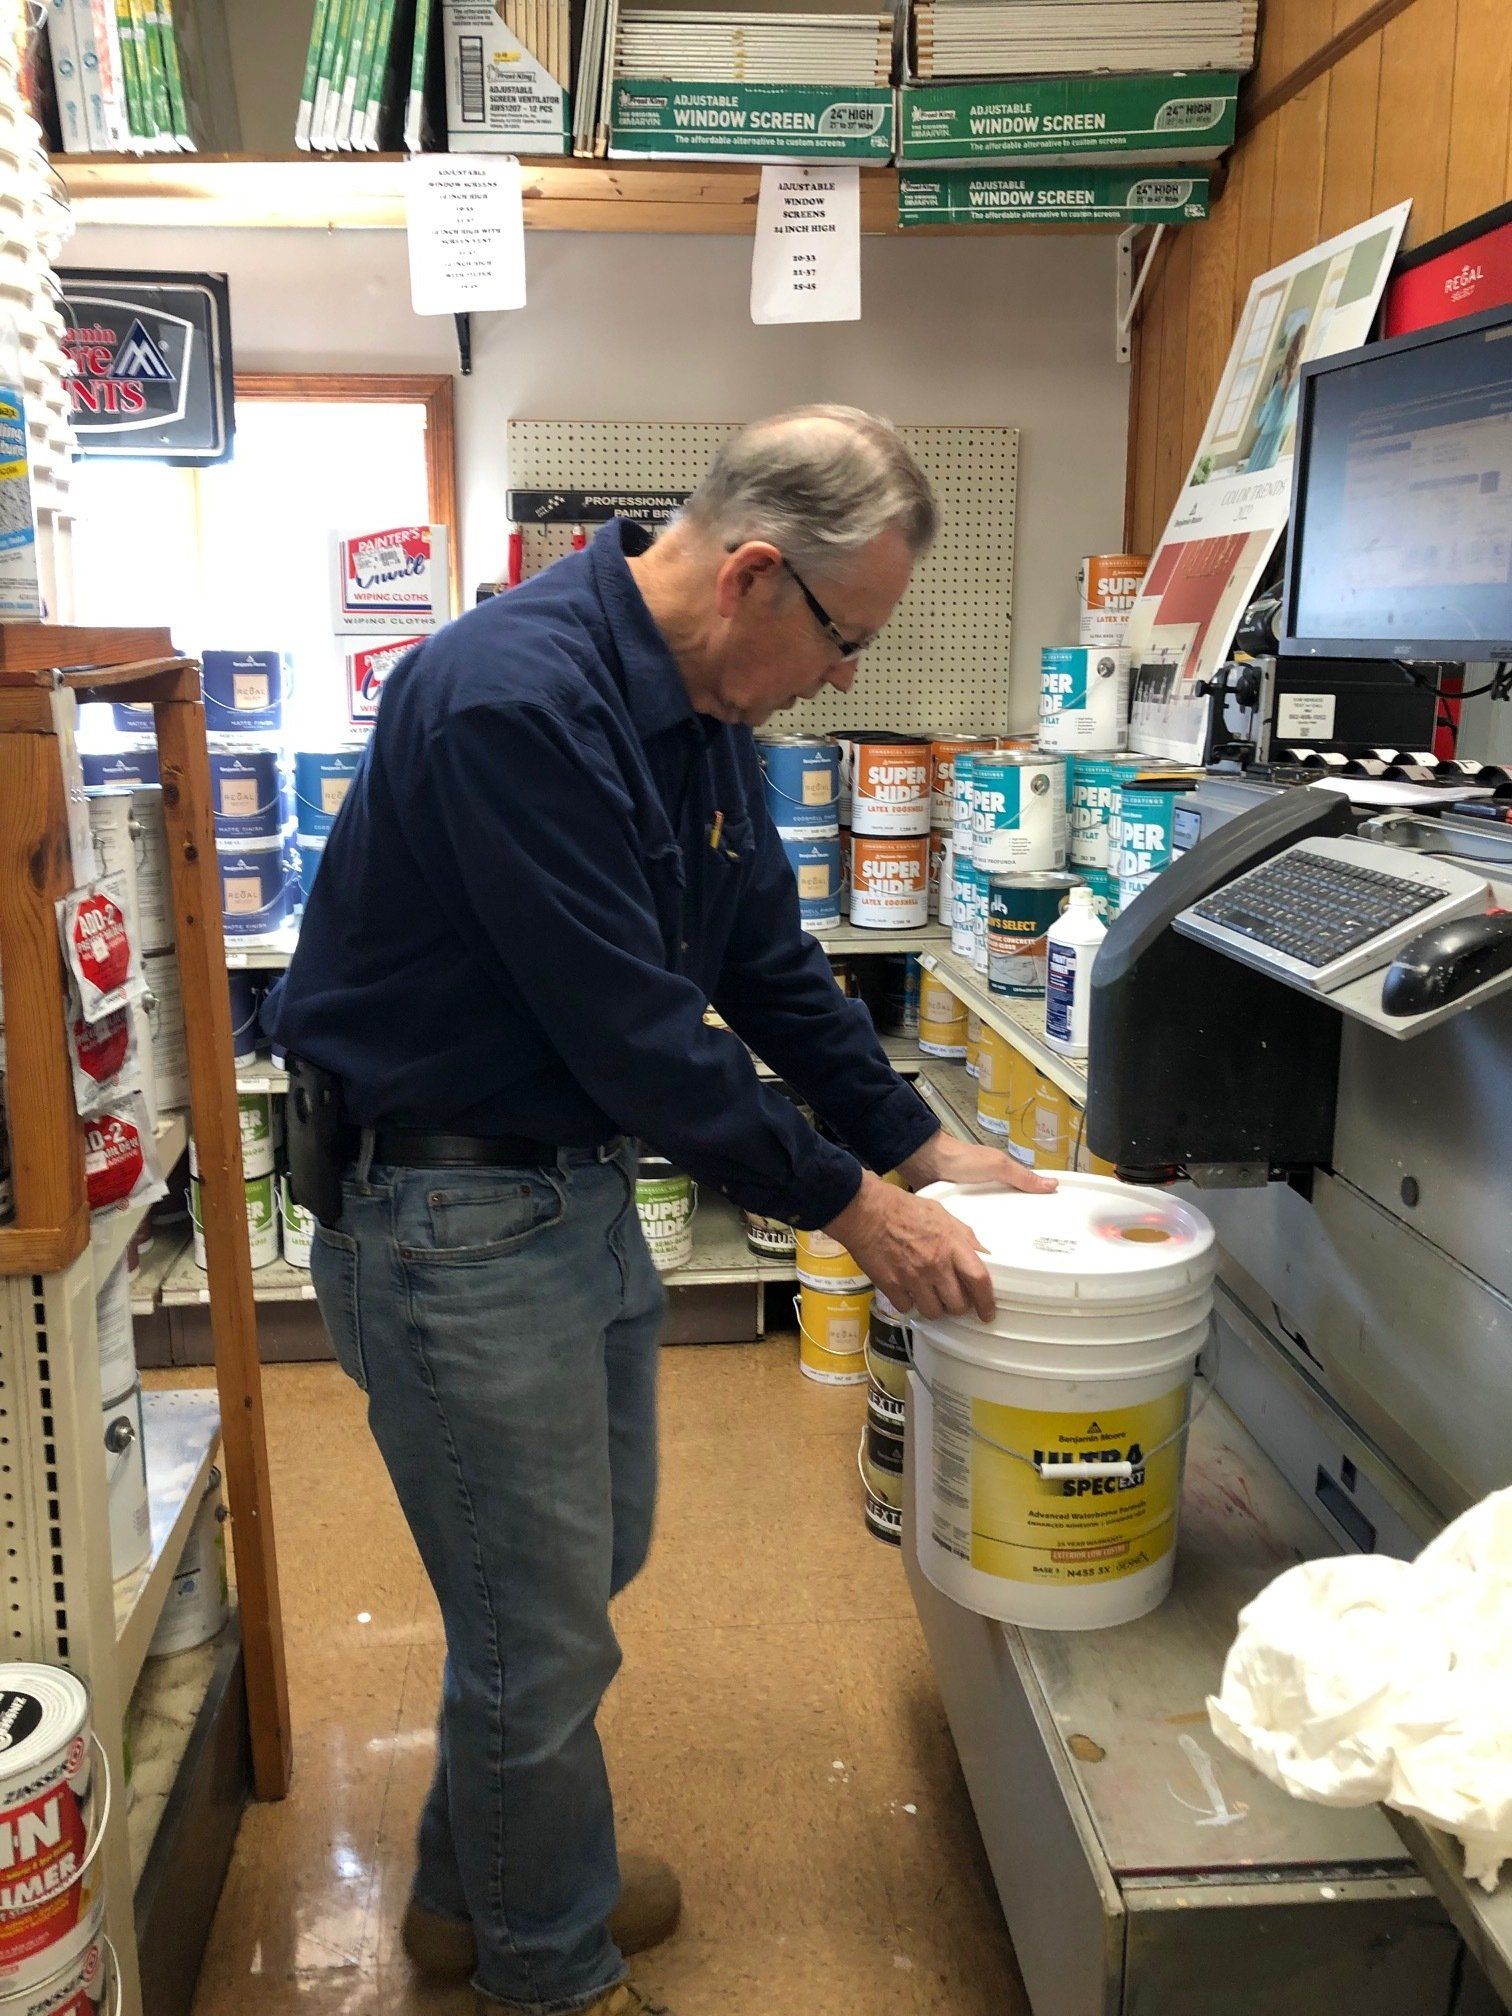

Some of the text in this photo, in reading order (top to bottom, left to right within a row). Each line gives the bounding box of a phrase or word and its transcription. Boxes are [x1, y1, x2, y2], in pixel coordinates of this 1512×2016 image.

[489, 86, 533, 94] ADJUSTABLE
[518, 96, 560, 104] VENTILATOR
[673, 95, 739, 107] ADJUSTABLE
[528, 105, 537, 113] 12
[539, 105, 553, 113] PCS
[848, 109, 874, 120] HIGH
[970, 103, 1032, 116] ADJUSTABLE
[1186, 103, 1211, 115] HIGH
[673, 109, 815, 130] WINDOW SCREEN
[969, 113, 1106, 135] WINDOW SCREEN
[675, 135, 846, 148] The affordable alternative to custom screens
[970, 137, 1127, 151] The affordable alternative to custom screens
[779, 183, 836, 191] ADJUSTABLE
[969, 181, 1025, 190] ADJUSTABLE
[1155, 185, 1179, 194] HIGH
[784, 197, 825, 206] WINDOW
[969, 190, 1095, 206] WINDOW SCREEN
[783, 210, 826, 219] SCREENS
[984, 211, 1020, 219] affordable
[785, 225, 809, 233] INCH
[811, 224, 836, 232] HIGH
[1444, 265, 1484, 294] REGAL
[1221, 479, 1286, 506] COLOR TRENDS
[584, 496, 680, 507] PROFESSIONAL
[614, 509, 650, 519] PAINT
[358, 527, 420, 553] PAINTER'S
[353, 592, 429, 602] WIPING CLOTHS
[343, 617, 436, 625] WIPING CLOTHS
[1097, 615, 1118, 623] LATEX
[237, 687, 265, 695] REGAL
[1045, 717, 1060, 725] FLAT
[868, 766, 926, 785] SUPER
[224, 792, 255, 801] REGAL
[875, 785, 920, 802] HIDE
[892, 805, 924, 813] EGGSHELL
[1082, 832, 1099, 840] FLAT
[862, 860, 920, 879] SUPER
[868, 879, 914, 895] HIDE
[228, 890, 257, 899] REGAL
[884, 898, 918, 906] EGGSHELL
[78, 903, 116, 939] ADD-2
[1002, 919, 1037, 931] SELECT
[636, 1197, 689, 1221] SUPER
[1058, 1432, 1127, 1444] Benjamin Moore
[1028, 1510, 1069, 1520] Advanced
[1071, 1509, 1118, 1519] Waterborne
[1119, 1500, 1147, 1513] Formula
[1027, 1520, 1065, 1528] ENHANCED
[1066, 1535, 1123, 1547] YEAR WARRANTY
[1053, 1550, 1087, 1560] EXTERIOR
[1087, 1549, 1102, 1558] LOW
[1032, 1565, 1053, 1574] BASE
